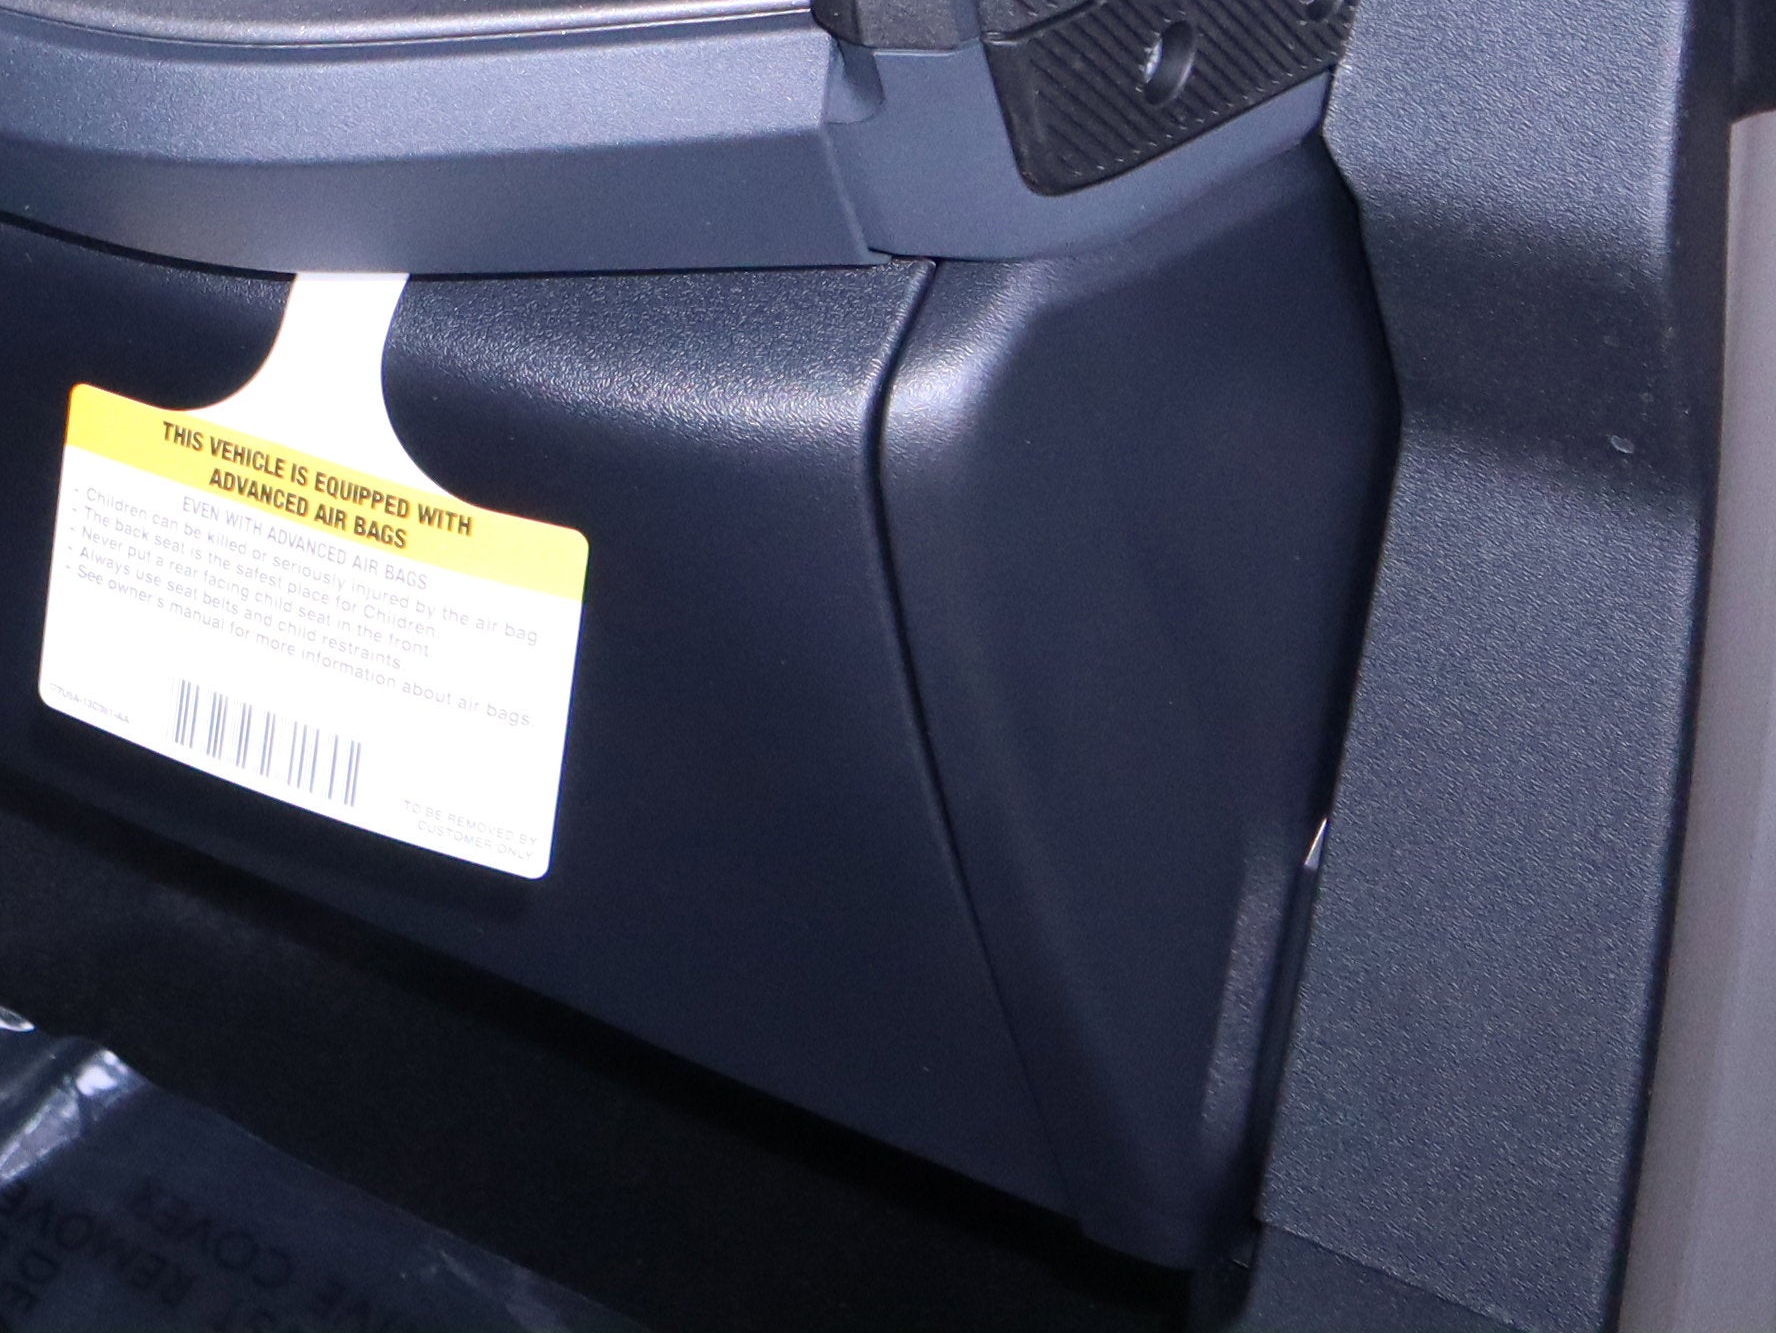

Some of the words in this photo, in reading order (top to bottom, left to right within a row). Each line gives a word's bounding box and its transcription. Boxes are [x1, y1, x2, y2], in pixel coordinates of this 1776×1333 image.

[162, 420, 204, 452] THIS
[209, 435, 286, 478] VEHICLE
[291, 463, 309, 486] IS
[314, 472, 410, 520] EQUIPPED
[417, 503, 473, 536] WITH
[209, 468, 309, 517] ADVANCED
[314, 504, 347, 531] AIR
[353, 516, 408, 549] BAGS
[82, 525, 122, 550] Never
[128, 546, 151, 564] put
[156, 557, 164, 567] a
[170, 561, 198, 578] rear
[203, 570, 249, 601] facing
[255, 591, 292, 613] child
[298, 606, 331, 626] seat
[337, 619, 351, 632] in
[358, 624, 383, 642] the
[84, 505, 110, 527] The
[115, 520, 150, 541] back
[155, 536, 185, 554] seat
[190, 548, 202, 560] is
[209, 552, 231, 570] the
[236, 563, 282, 589] safest
[288, 581, 329, 604] place
[336, 595, 357, 613] for
[86, 487, 147, 520] Children
[152, 513, 178, 530] can
[184, 524, 201, 539] be
[207, 530, 248, 556] killed
[252, 549, 267, 562] or
[273, 556, 345, 591] seriously
[351, 578, 409, 608] injured
[416, 600, 436, 619] by
[443, 607, 469, 626] the
[476, 617, 498, 632] air
[504, 623, 538, 646] bag
[182, 496, 219, 521] EVEN
[225, 511, 263, 536] WITH
[267, 526, 346, 565] ADVANCED
[353, 555, 378, 576] AIR
[384, 564, 428, 590] BAGS
[80, 547, 130, 575] Always
[136, 570, 162, 586] use
[167, 580, 197, 600] seat
[203, 591, 239, 615] belts
[244, 608, 272, 626] and
[278, 620, 317, 642] child
[77, 564, 103, 585] See
[170, 602, 225, 631] manual
[229, 621, 250, 638] for
[256, 633, 296, 655] more
[302, 651, 396, 688] information
[402, 682, 451, 705] about
[458, 697, 480, 712] air
[486, 704, 535, 727] bags.
[404, 799, 421, 813] TO
[426, 807, 442, 820] BE
[448, 813, 514, 840] REMOVED
[520, 834, 538, 845] BY
[418, 820, 492, 848] CUSTOMER
[497, 844, 533, 860] ONLY
